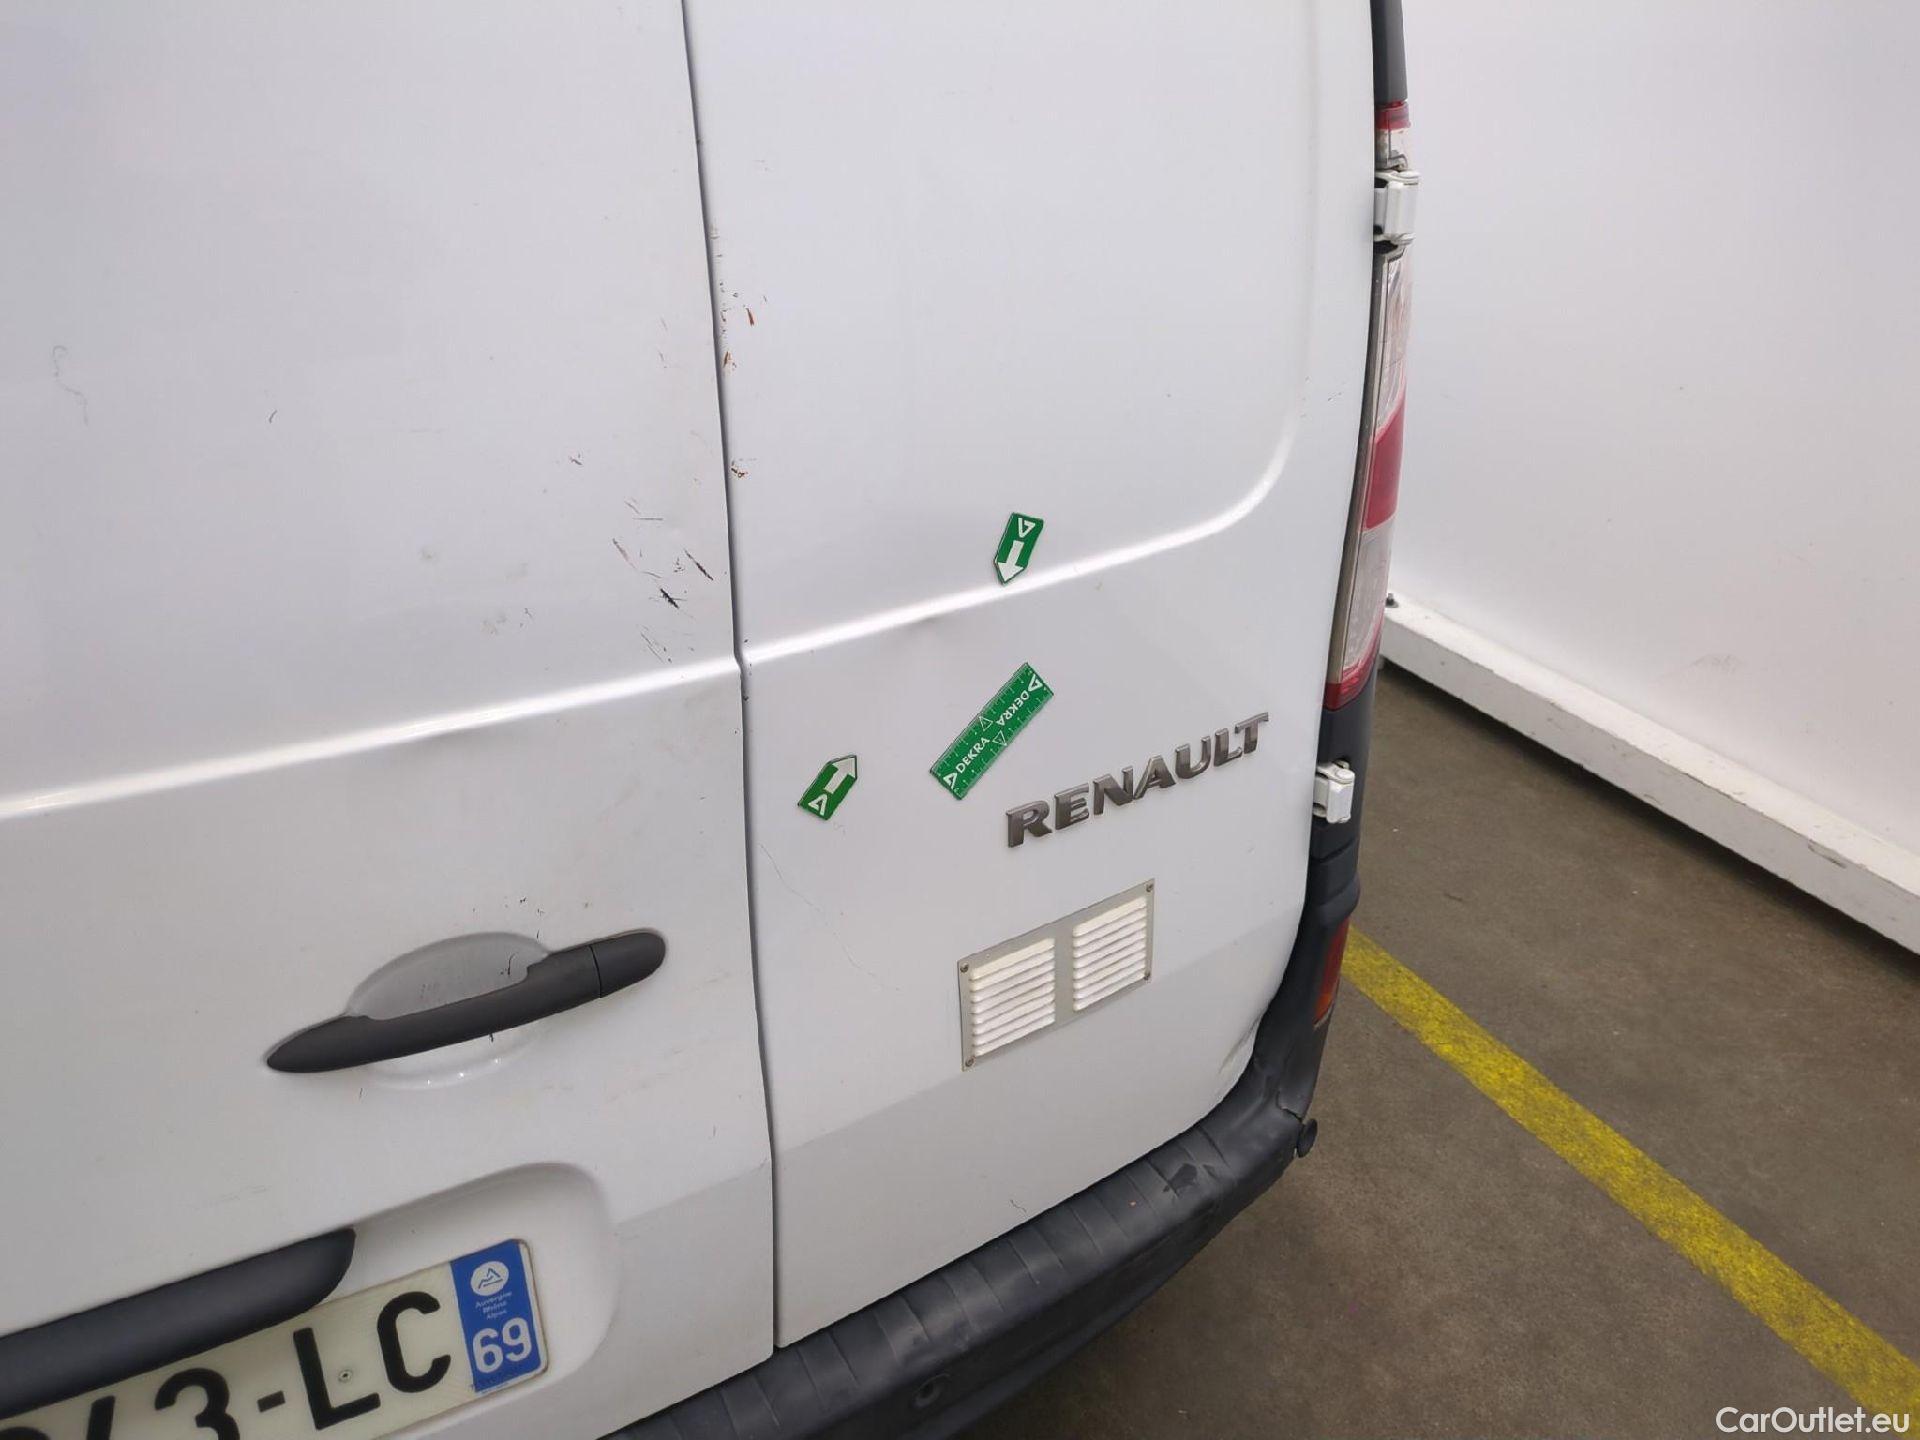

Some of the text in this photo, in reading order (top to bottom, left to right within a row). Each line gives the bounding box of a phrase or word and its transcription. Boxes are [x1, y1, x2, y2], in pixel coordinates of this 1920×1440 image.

[996, 689, 1030, 727] DEKRA
[955, 736, 990, 774] DEKRA
[1006, 712, 1269, 848] RENAULT
[472, 1317, 532, 1373] 69
